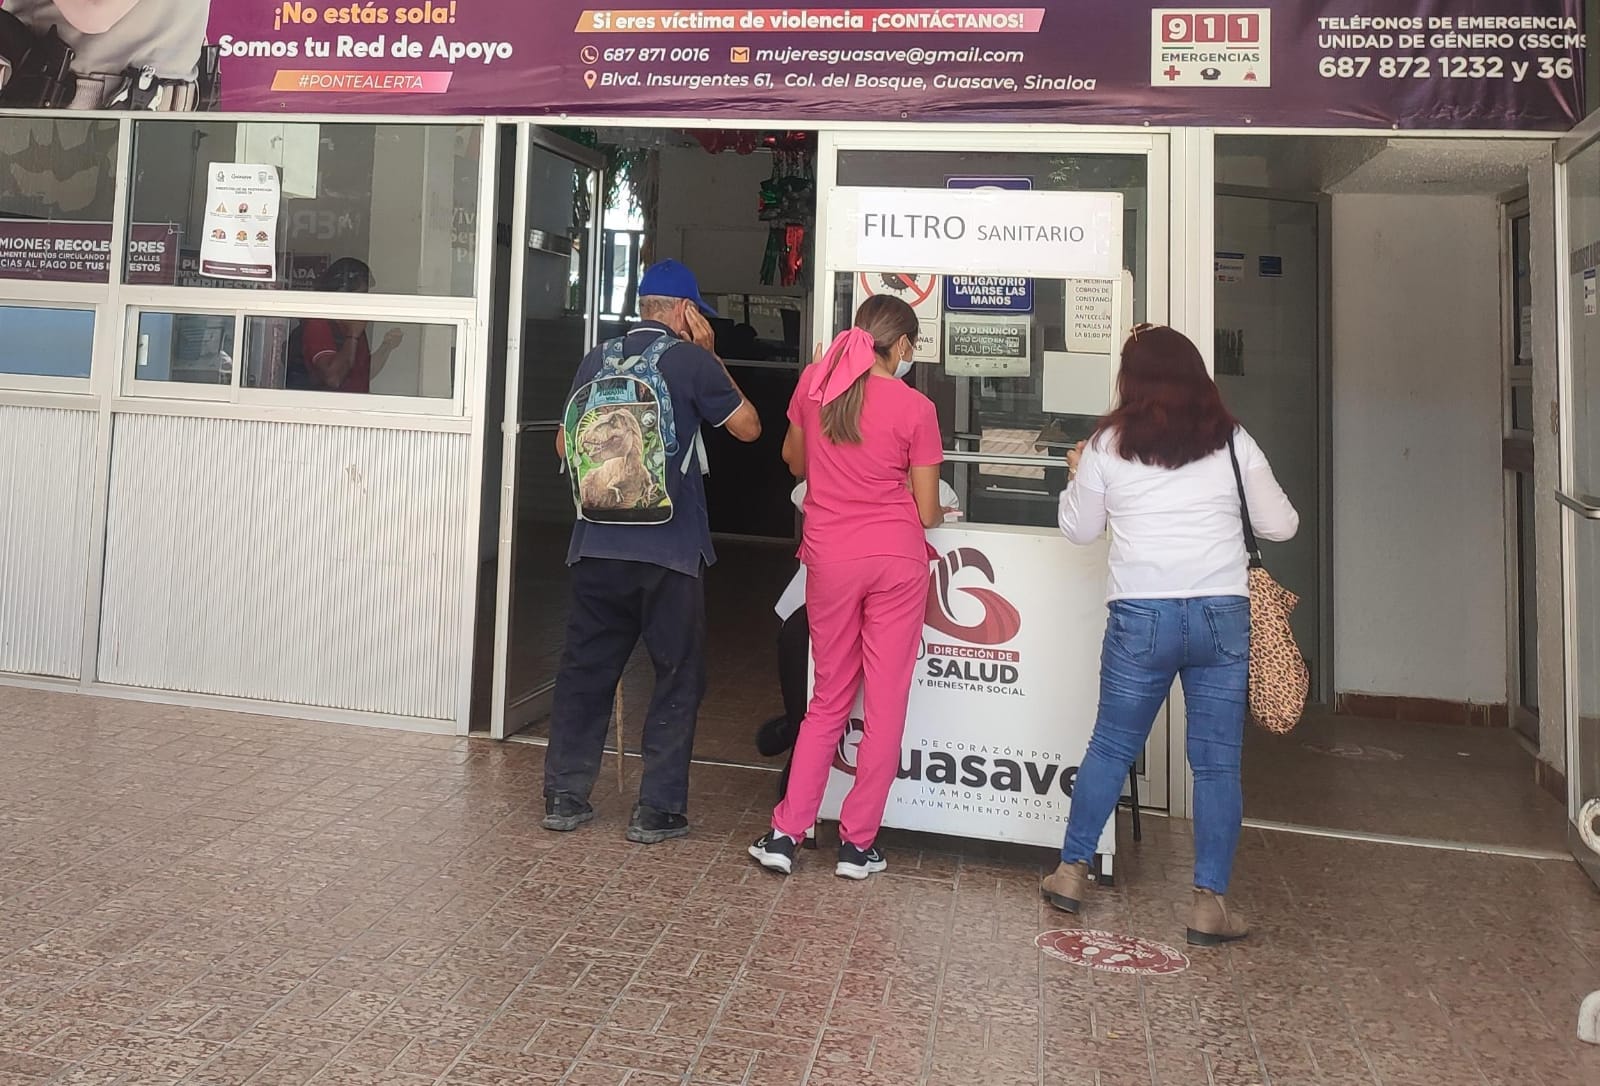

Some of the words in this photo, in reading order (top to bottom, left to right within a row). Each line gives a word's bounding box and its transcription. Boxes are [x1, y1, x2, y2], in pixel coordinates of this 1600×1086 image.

[273, 2, 318, 30] ¡No
[323, 1, 389, 24] estás
[394, 1, 457, 24] sola!
[592, 11, 611, 29] Si
[615, 14, 656, 29] eres
[660, 11, 735, 29] víctima
[739, 11, 765, 29] de
[770, 11, 863, 29] violencia
[871, 9, 1024, 32] ¡CONTÁCTANOS!
[1317, 15, 1423, 30] TELÉFONOS
[1428, 16, 1453, 30] DE
[1457, 16, 1577, 30] EMERGENCIA
[1318, 34, 1393, 49] UNIDAD
[1399, 34, 1426, 49] DE
[1430, 31, 1514, 49] GÉNERO
[219, 35, 299, 58] Somos
[304, 37, 331, 58] tu
[336, 35, 386, 58] Red
[390, 36, 423, 58] de
[429, 36, 513, 64] Apoyo
[603, 48, 634, 62] 687
[638, 48, 666, 62] 871
[670, 48, 710, 62] 0016
[755, 46, 1024, 65] mujeresguasave@gmail.com
[1161, 52, 1260, 63] EMERGENCIAS
[1318, 56, 1371, 78] 687
[1378, 57, 1431, 78] 872
[1438, 57, 1504, 78] 1232
[1511, 60, 1529, 82] y
[1536, 56, 1573, 78] 36
[298, 75, 424, 90] #PONTEALERTA
[600, 72, 642, 87] Blvd.
[646, 72, 749, 89] Insurgentes
[753, 73, 774, 88] 61,
[784, 73, 816, 87] Col.
[821, 73, 850, 88] del
[854, 74, 927, 91] Bosque,
[933, 75, 1018, 92] Guasave,
[1024, 75, 1097, 91] Sinaloa
[864, 213, 966, 240] FILTRO
[977, 224, 1085, 242] SANITARIO
[54, 239, 166, 253] RECOLEORES
[25, 259, 38, 268] AL
[40, 260, 67, 269] PAGO
[69, 261, 83, 270] DE
[85, 261, 105, 270] TUS
[58, 252, 105, 261] CIRCULANDO
[952, 276, 1026, 286] OBLIGATORIO
[955, 286, 1004, 296] LAVARSE
[1005, 287, 1026, 297] LAS
[970, 296, 1012, 305] MANOS
[933, 645, 994, 660] DIRECCIÓN
[997, 651, 1013, 661] DE
[926, 657, 1019, 684] SALUD
[917, 678, 925, 687] Y
[927, 679, 985, 692] BIENESTAR
[986, 685, 1026, 696] SOCIAL
[921, 738, 939, 748] DE
[945, 741, 1024, 757] CORAZÓN
[1031, 750, 1062, 761] POR
[911, 799, 1011, 817] AYUNTAMIENTO
[1017, 811, 1071, 823] 2021-20
